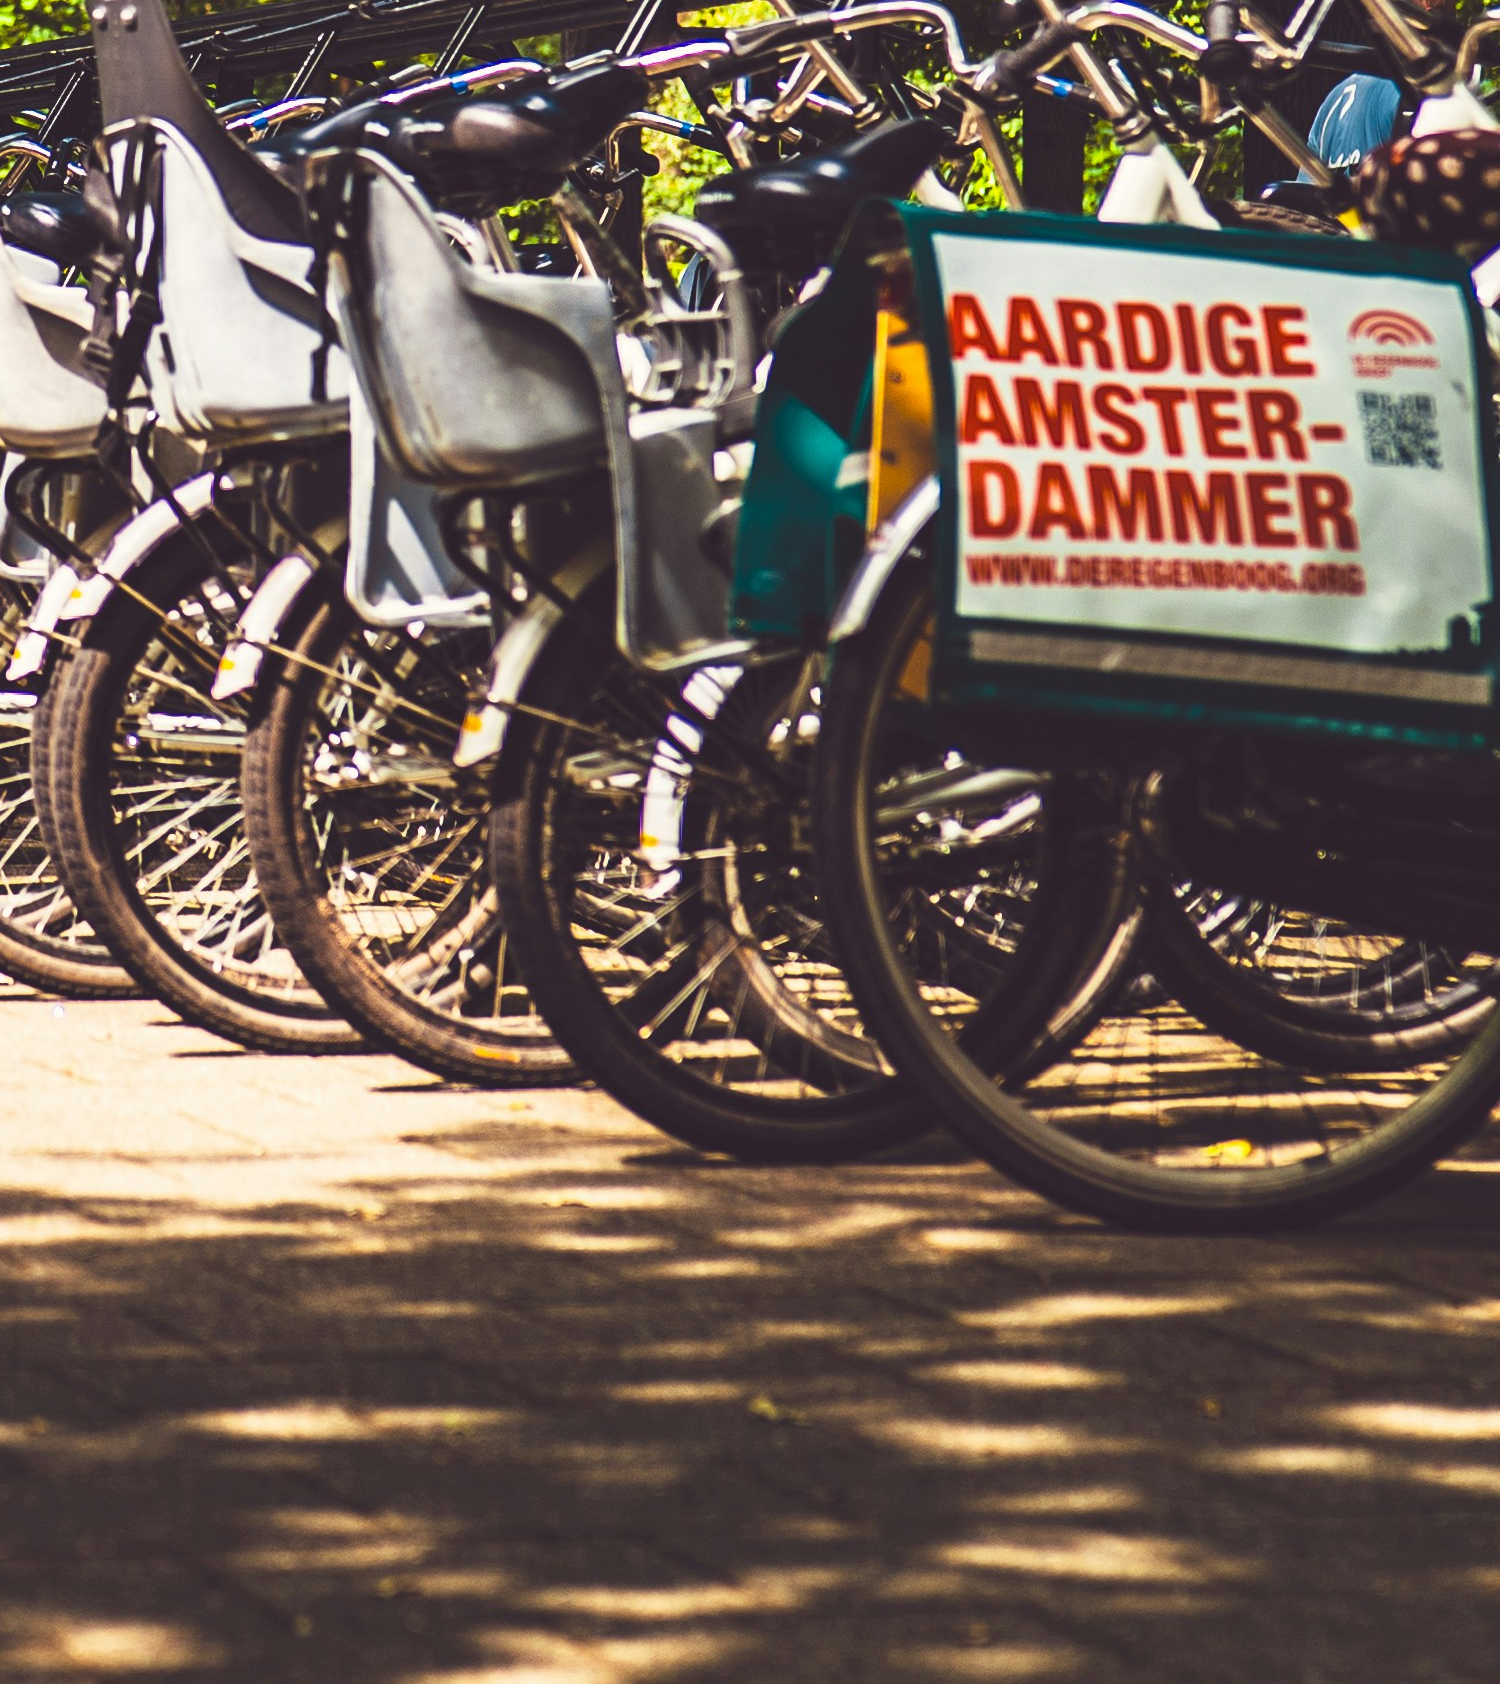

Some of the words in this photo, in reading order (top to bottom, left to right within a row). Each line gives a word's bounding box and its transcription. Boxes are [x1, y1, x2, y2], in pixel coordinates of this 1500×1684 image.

[949, 292, 1316, 378] AARDIGE
[959, 373, 1346, 461] AMSTER-
[967, 460, 1359, 552] DAMMER
[966, 554, 1367, 597] WWW.DEREGENBOOG.ORG
